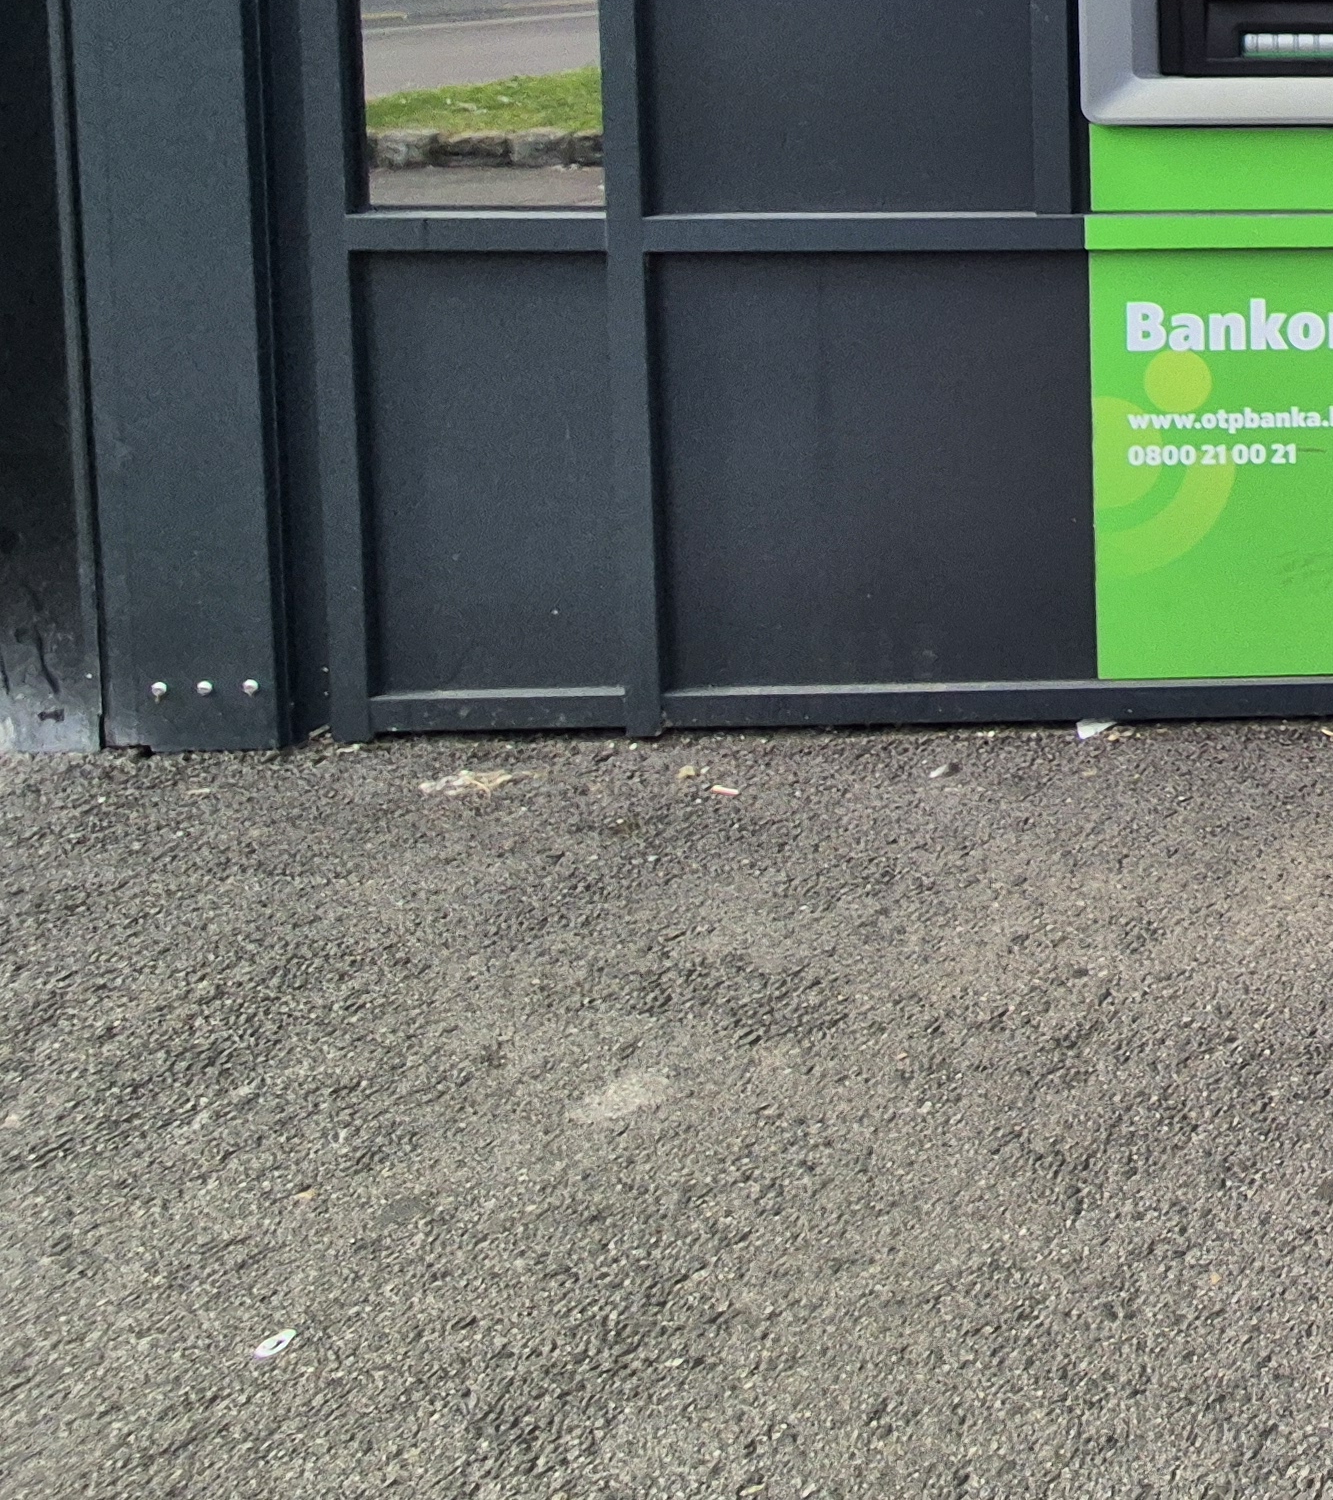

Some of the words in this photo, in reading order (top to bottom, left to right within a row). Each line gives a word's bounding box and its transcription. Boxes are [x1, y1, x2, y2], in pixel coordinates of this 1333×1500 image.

[1127, 444, 1196, 466] 0800
[1200, 444, 1226, 465] 21
[1232, 444, 1267, 465] 00
[1271, 443, 1298, 465] 21
